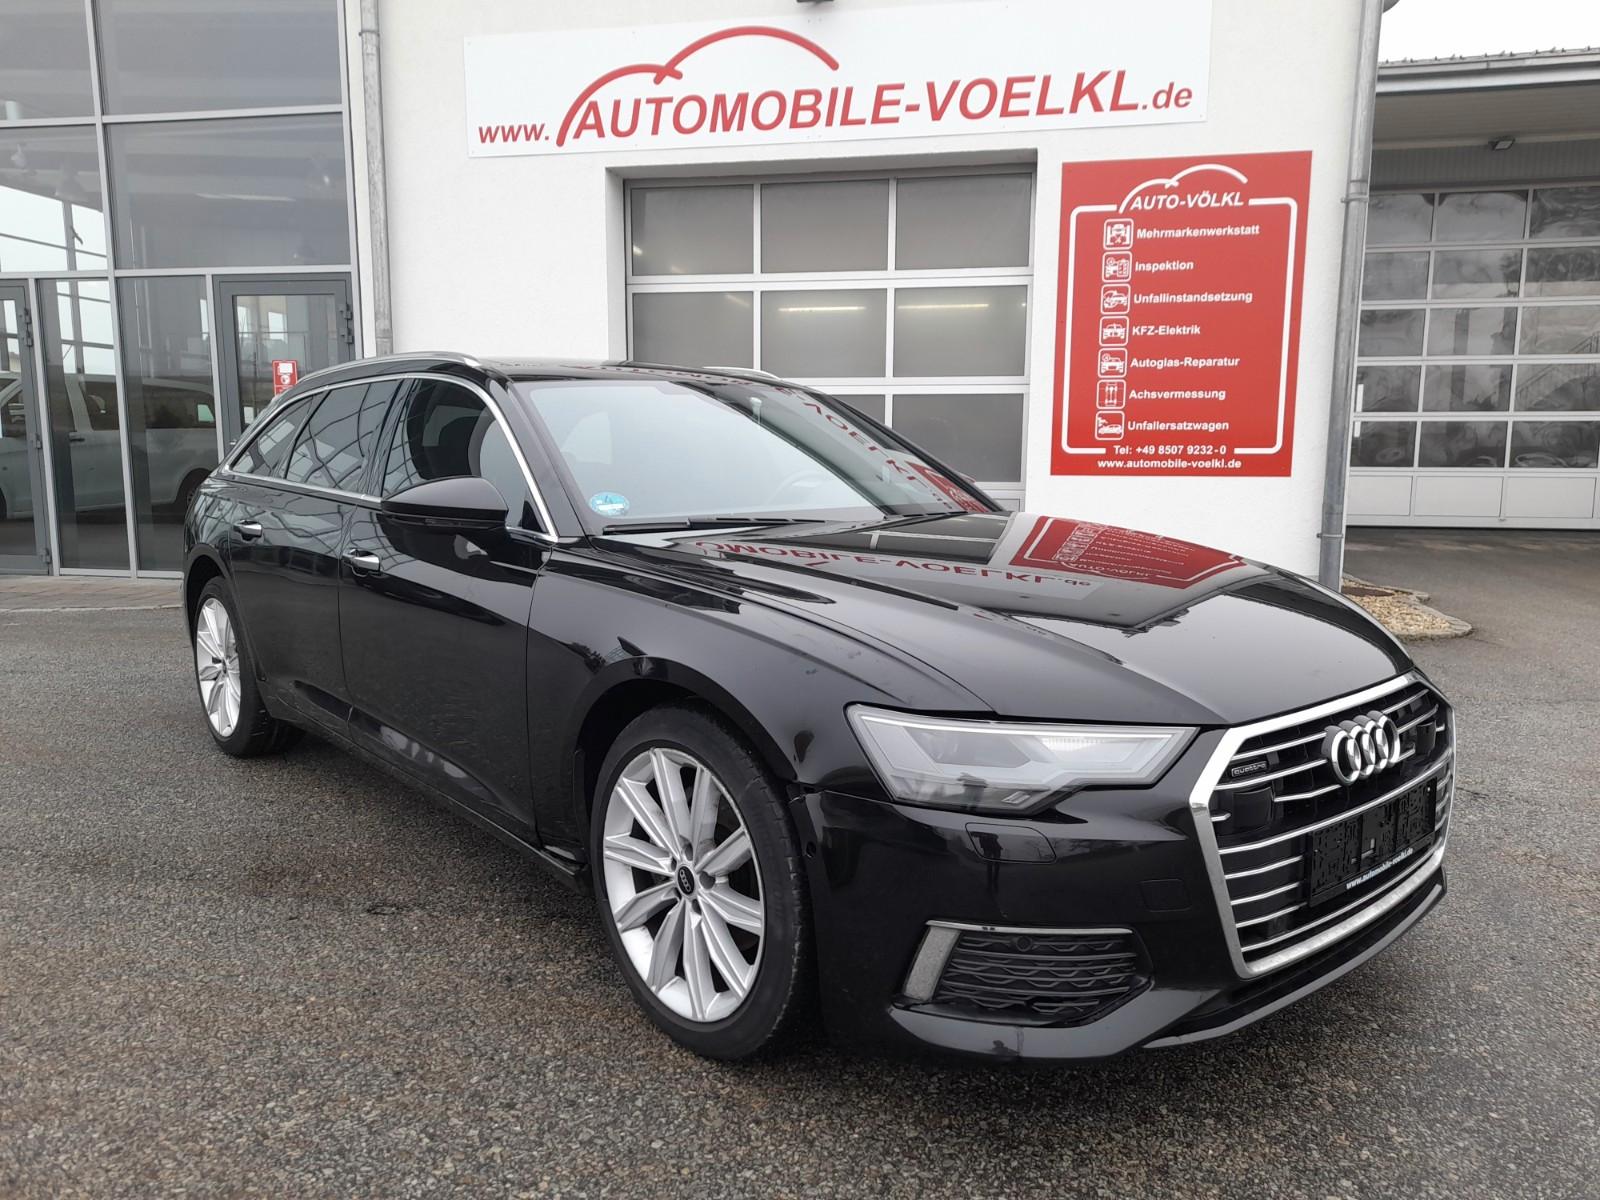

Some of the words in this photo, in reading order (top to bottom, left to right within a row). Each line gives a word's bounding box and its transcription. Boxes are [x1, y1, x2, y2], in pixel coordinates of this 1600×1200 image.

[1129, 190, 1245, 211] AUTO-VÖLKL
[1136, 224, 1261, 240] Mehrmarkenwerkstatt
[1134, 259, 1195, 274] Inspektion
[1133, 291, 1254, 305] Unfallinstandsetzung
[1131, 324, 1202, 336] KFZ-Elektrik
[1129, 356, 1241, 370] Autoglas-Reparatur
[1128, 389, 1227, 402] Achsvermessung
[1127, 420, 1230, 433] Unfallersatzwagen
[1113, 445, 1133, 455] Tel:
[1135, 445, 1156, 455] +49
[1158, 445, 1185, 455] 8507
[1097, 458, 1243, 469] www.automobile-voelkl.de
